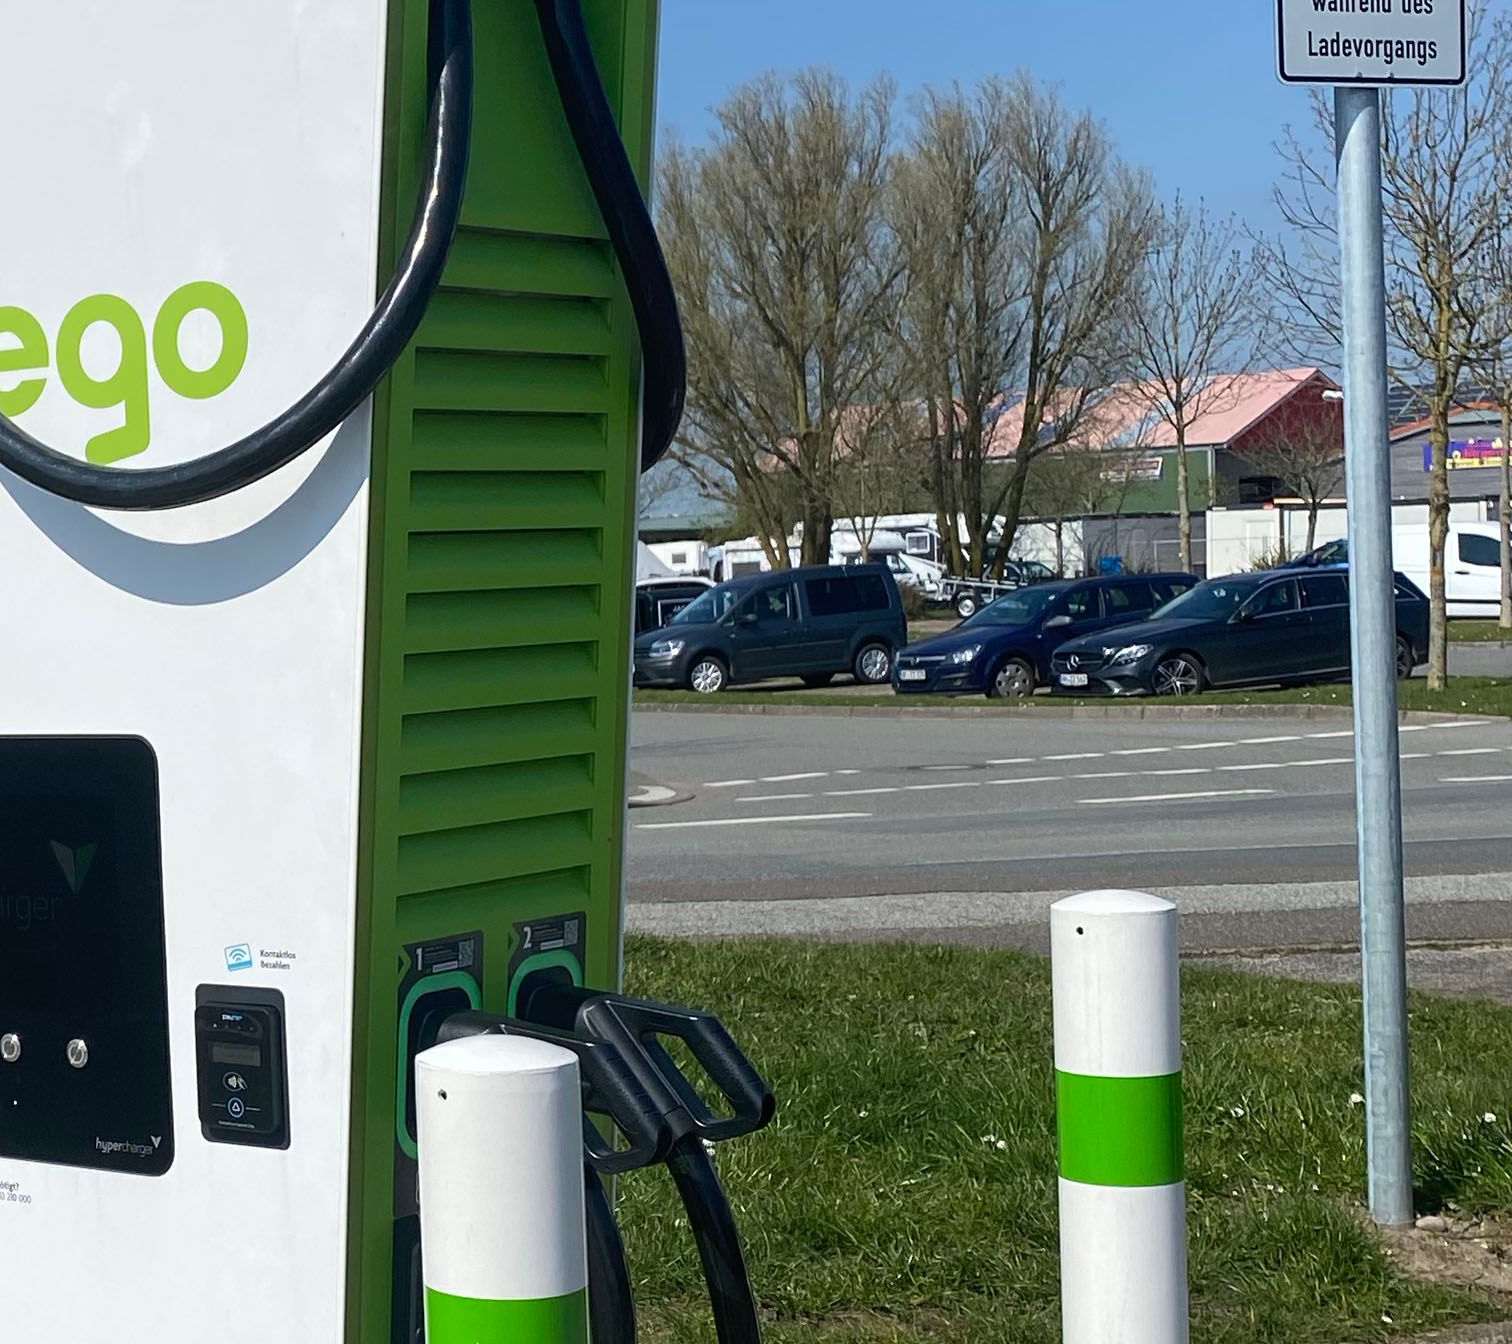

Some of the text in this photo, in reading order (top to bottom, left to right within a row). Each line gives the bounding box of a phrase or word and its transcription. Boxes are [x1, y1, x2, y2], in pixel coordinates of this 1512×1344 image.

[1307, 30, 1438, 66] Ladevorgangs
[523, 926, 532, 949] 2
[416, 948, 423, 971] 1
[95, 1136, 154, 1158] hypercharger
